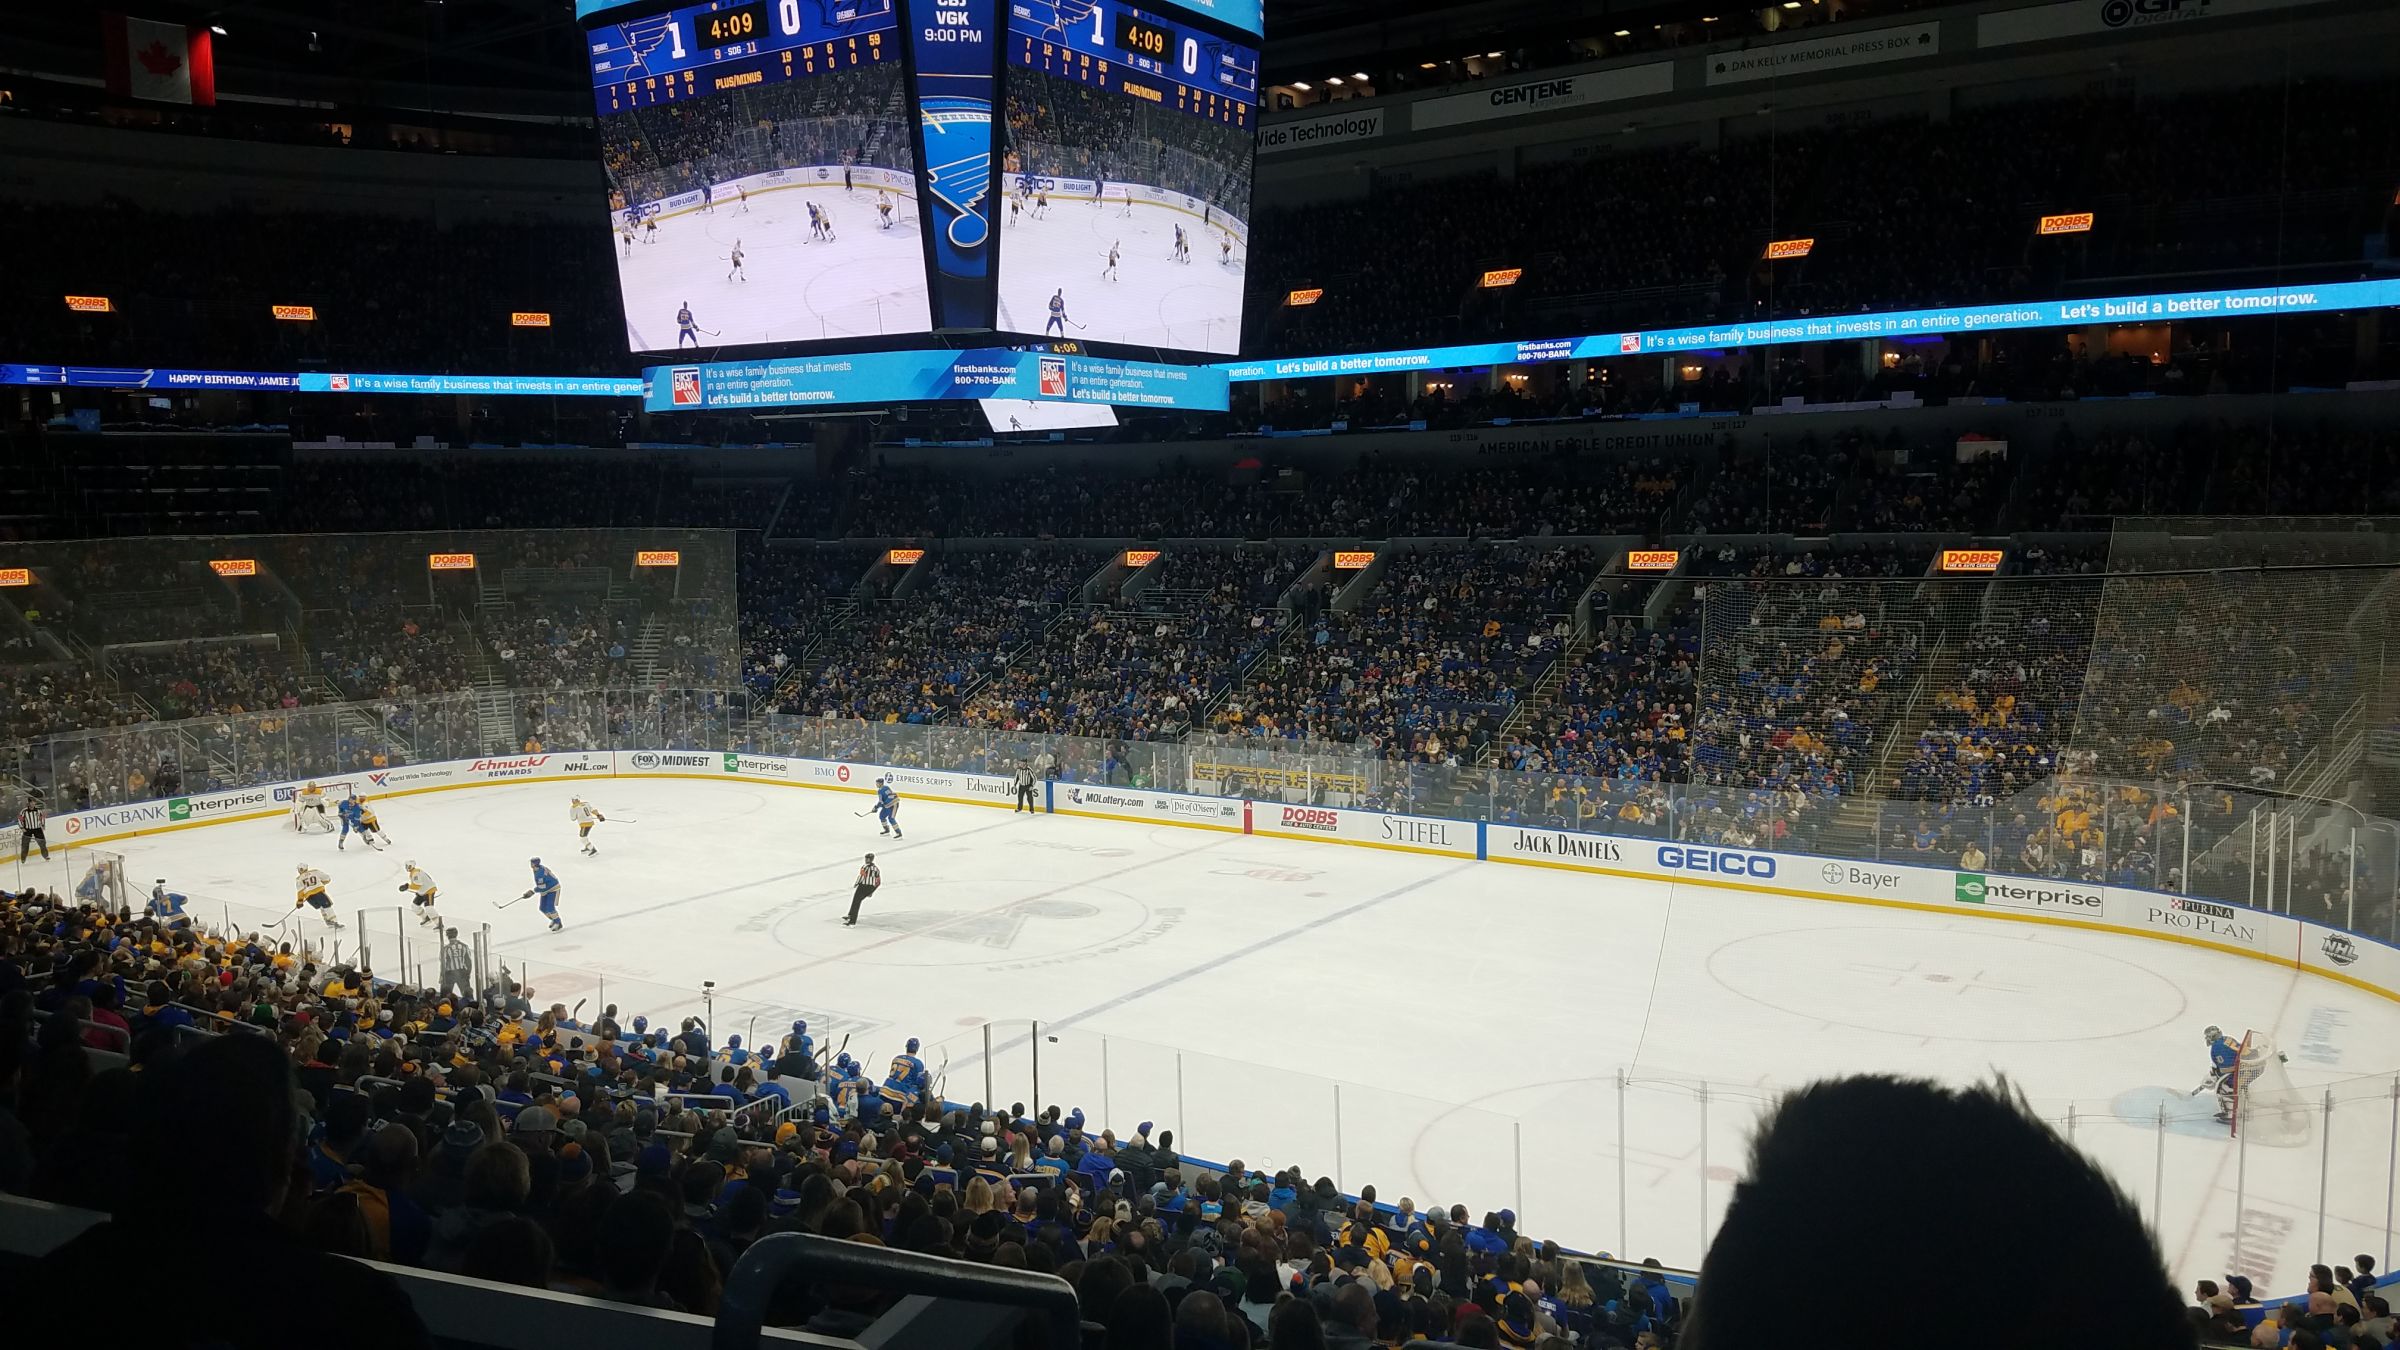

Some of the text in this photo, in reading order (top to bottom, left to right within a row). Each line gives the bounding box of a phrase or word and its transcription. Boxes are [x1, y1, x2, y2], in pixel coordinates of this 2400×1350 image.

[780, 0, 800, 35] 0
[936, 11, 969, 26] VGK
[711, 13, 752, 39] 4:09
[1091, 6, 1104, 46] 1
[668, 22, 685, 58] 1
[924, 28, 982, 42] 9:00 PM
[1128, 25, 1163, 53] 4:09
[1182, 38, 1198, 74] 0
[1732, 36, 1911, 72] DAN KELLY MEMORIAL PRESS BOX
[716, 71, 763, 90] PLUS/MINUS
[1124, 82, 1162, 102] PLUS/MINUS
[1490, 80, 1572, 106] CENTENE
[1290, 116, 1378, 142] Technology
[2045, 215, 2090, 228] DOBBS
[1772, 241, 1812, 252] DOBBS
[68, 298, 106, 306] DOBBS
[276, 307, 310, 315] DOBBS
[516, 314, 548, 322] DOBBS
[1647, 291, 2318, 347] It's a wise family business that invests in an entire generation. Let's build a better tomorrow.
[1054, 342, 1078, 353] 4:09
[1518, 340, 1572, 351] firstbanks.com
[1518, 350, 1572, 360] 800-760-BANK
[706, 361, 852, 378] It's a wise family business that invests
[954, 364, 1016, 375] firstbanks.com
[1042, 362, 1058, 372] FIRST
[1276, 361, 1301, 374] Let's
[1302, 360, 1329, 373] build
[1340, 357, 1372, 370] better
[1374, 354, 1430, 368] tomorrow.
[169, 374, 202, 384] HAPPY
[204, 375, 258, 386] BIRTHDAY,
[258, 376, 290, 386] JAMIE
[674, 372, 692, 382] FIRST
[708, 378, 794, 391] in an entire generation.
[954, 376, 1016, 385] 800-760-BANK
[1042, 371, 1061, 382] BANK
[355, 378, 370, 388] It's
[384, 379, 408, 389] wise
[411, 378, 440, 392] family
[444, 379, 490, 390] business
[493, 380, 512, 390] that
[516, 380, 551, 391] invests
[554, 381, 564, 391] in
[567, 383, 580, 391] an
[582, 382, 609, 392] entire
[674, 381, 694, 391] BANK
[708, 394, 728, 405] Let's
[730, 392, 752, 404] build
[761, 390, 788, 402] better
[790, 388, 835, 401] tomorrow.
[1478, 439, 1549, 455] AMERICAN
[1605, 434, 1660, 450] CREDIT
[1664, 433, 1714, 448] UNION
[434, 556, 471, 564] DOBBS
[642, 552, 676, 560] DOBBS
[1338, 554, 1372, 562] DOBBS
[1632, 553, 1676, 562] DOBBS
[1948, 552, 2000, 564] DOBBS
[467, 756, 550, 772] Schnucks
[637, 755, 710, 768] FOX MIDWEST
[728, 756, 787, 774] enterprise
[405, 773, 420, 781] Wide
[420, 769, 452, 780] Technology
[488, 768, 532, 778] REWARDS
[814, 767, 834, 777] BMO
[896, 774, 952, 787] EXPRESS SCRIPTS
[966, 778, 1038, 798] Edward Jos
[174, 791, 266, 816] enterprise
[1085, 792, 1144, 808] MOLottery.com
[1282, 807, 1338, 825] DOBBS
[1382, 815, 1452, 846] STIFEL
[1514, 830, 1552, 854] JACK
[1657, 846, 1776, 879] GEICO
[1848, 868, 1900, 890] Bayer
[1963, 880, 2102, 908] enterprise
[2183, 902, 2232, 920] PURINA
[2148, 908, 2256, 942] PRO PLAN
[2321, 937, 2359, 961] NHL
